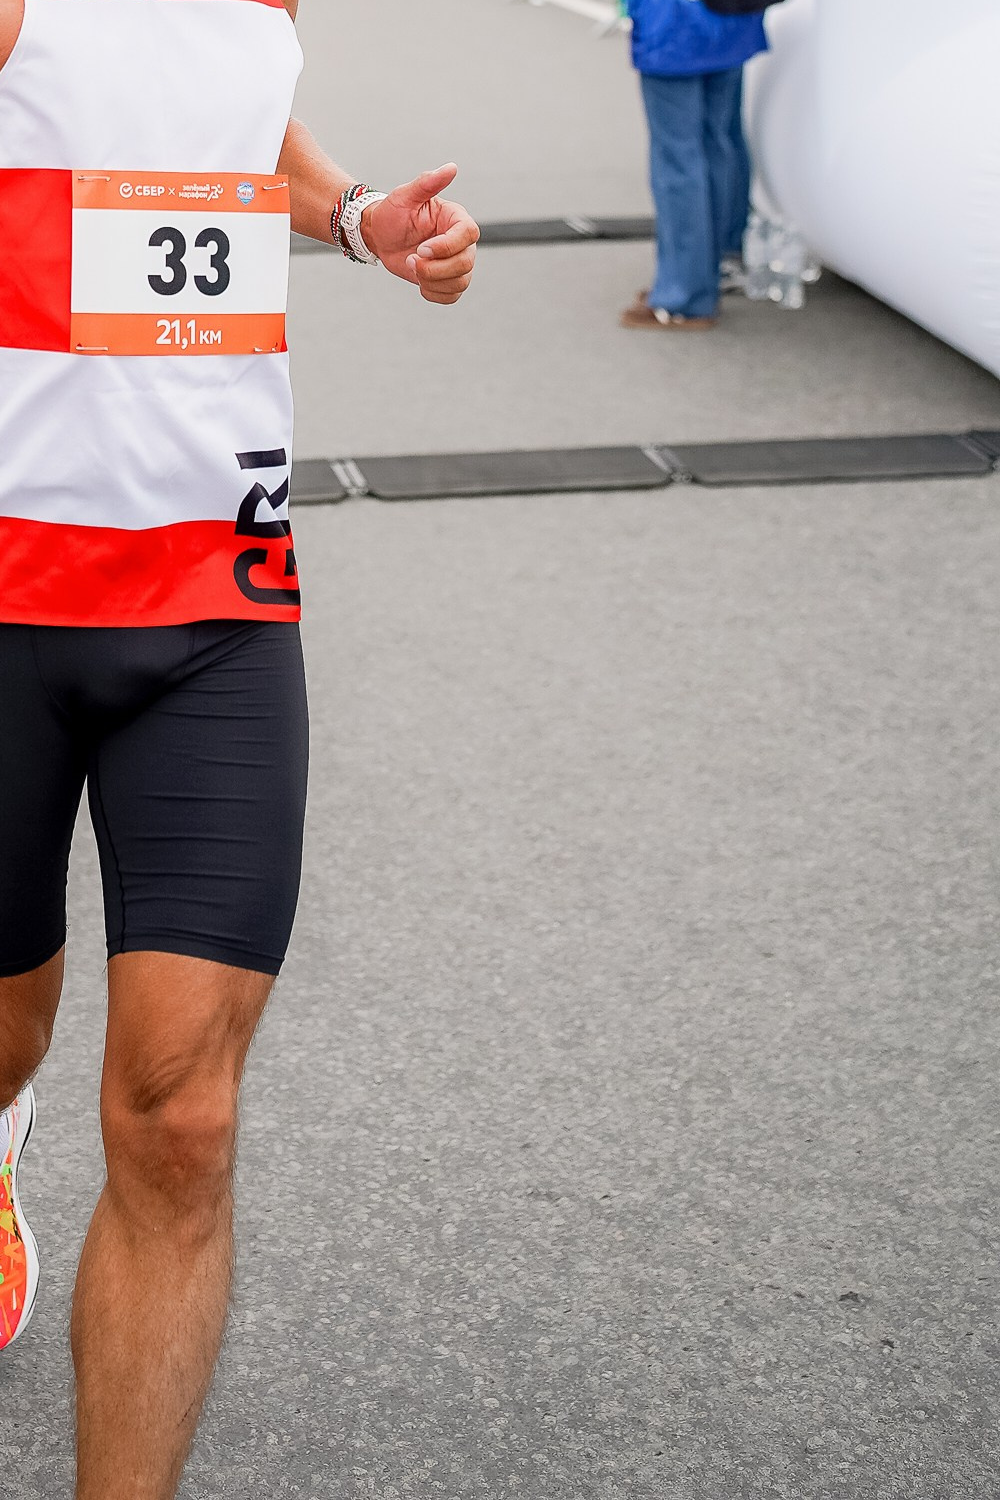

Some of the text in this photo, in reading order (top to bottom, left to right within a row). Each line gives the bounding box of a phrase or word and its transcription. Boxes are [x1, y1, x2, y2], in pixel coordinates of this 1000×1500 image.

[134, 184, 165, 197] СБЕР
[147, 226, 231, 297] 33
[155, 318, 197, 350] 21,1
